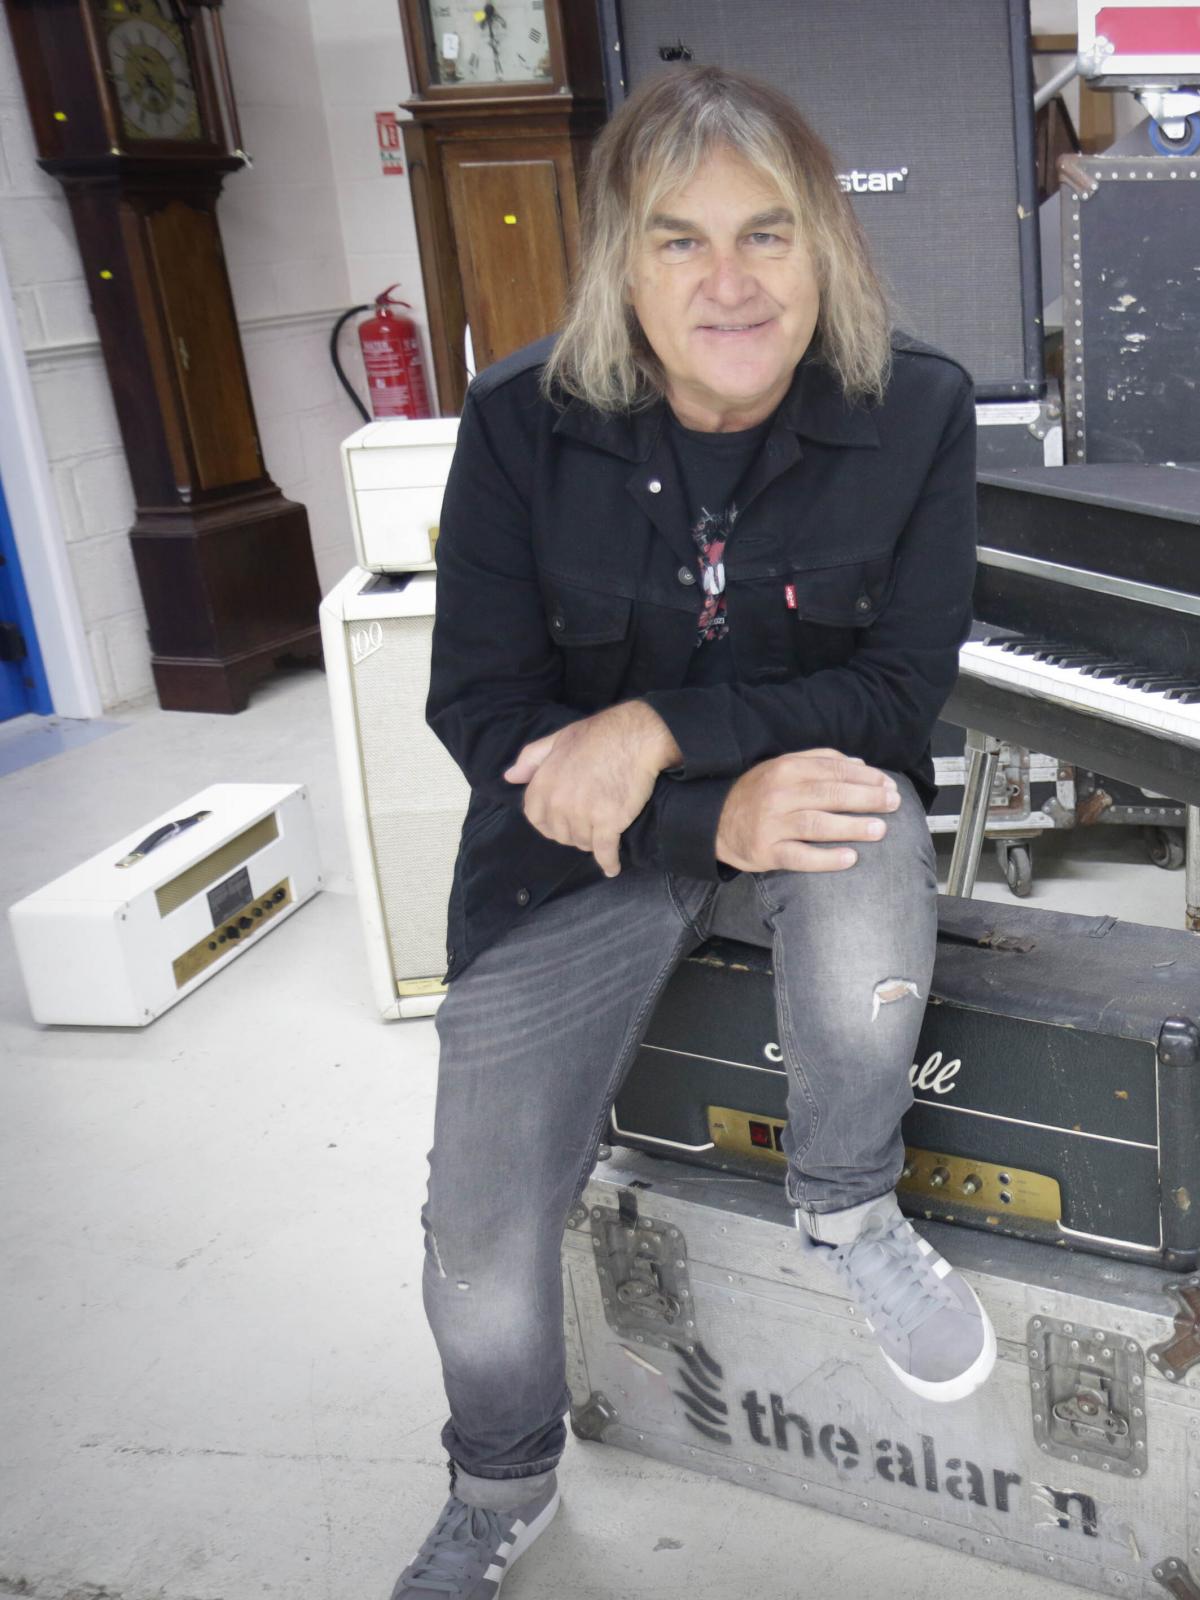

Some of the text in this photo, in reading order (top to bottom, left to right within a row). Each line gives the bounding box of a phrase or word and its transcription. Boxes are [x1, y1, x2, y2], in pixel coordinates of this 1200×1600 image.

[835, 169, 904, 192] star
[350, 621, 384, 664] 100
[741, 1390, 859, 1469] the
